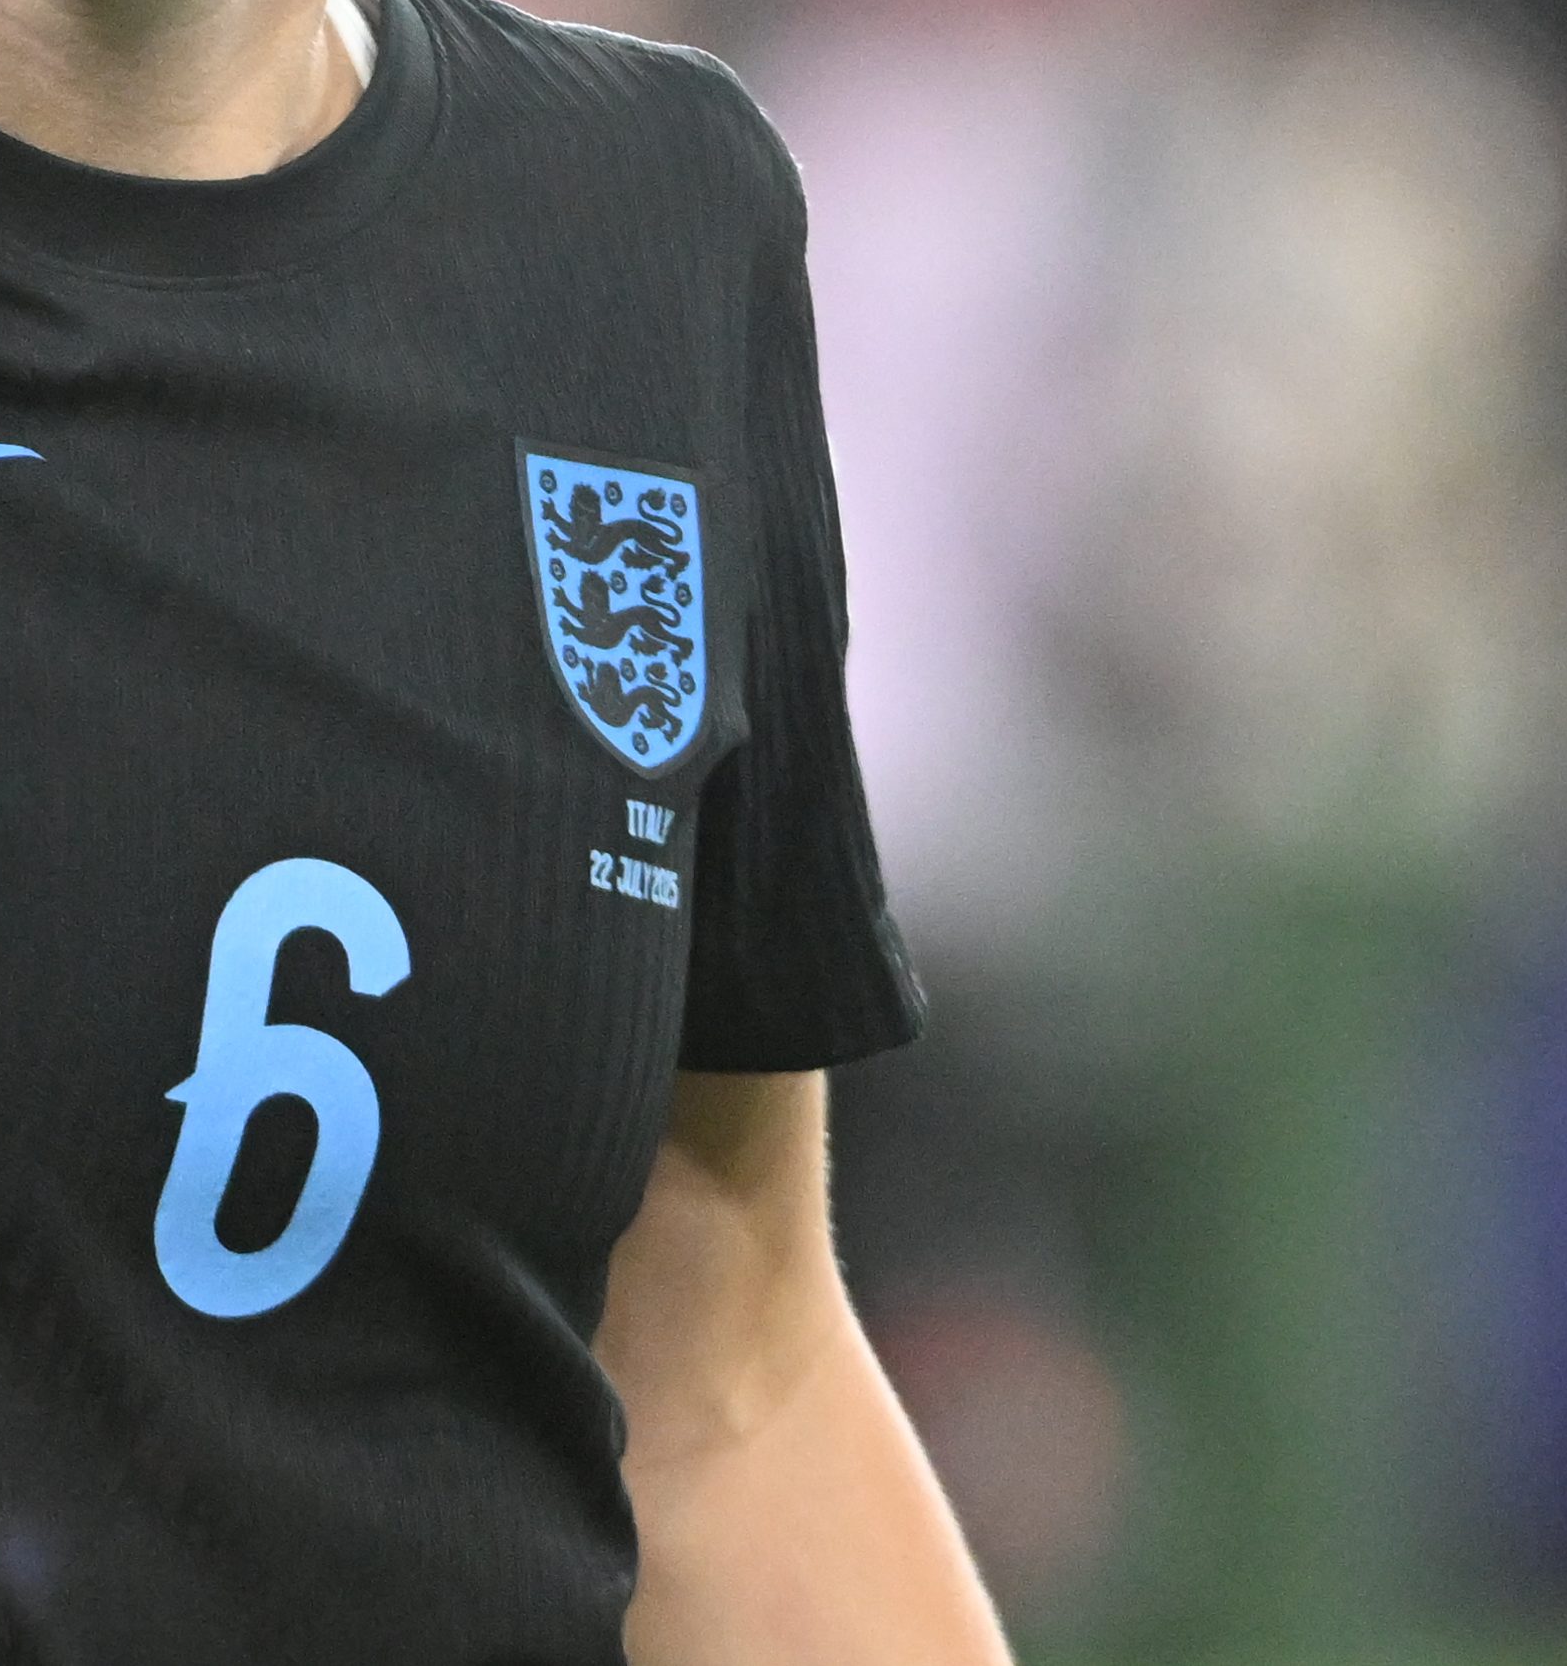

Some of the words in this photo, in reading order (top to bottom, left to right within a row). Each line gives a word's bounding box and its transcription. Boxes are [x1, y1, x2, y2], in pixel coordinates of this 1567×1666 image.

[626, 799, 675, 845] ITALY
[590, 849, 613, 891] 22
[616, 855, 652, 900] JULY
[154, 857, 412, 1319] 6
